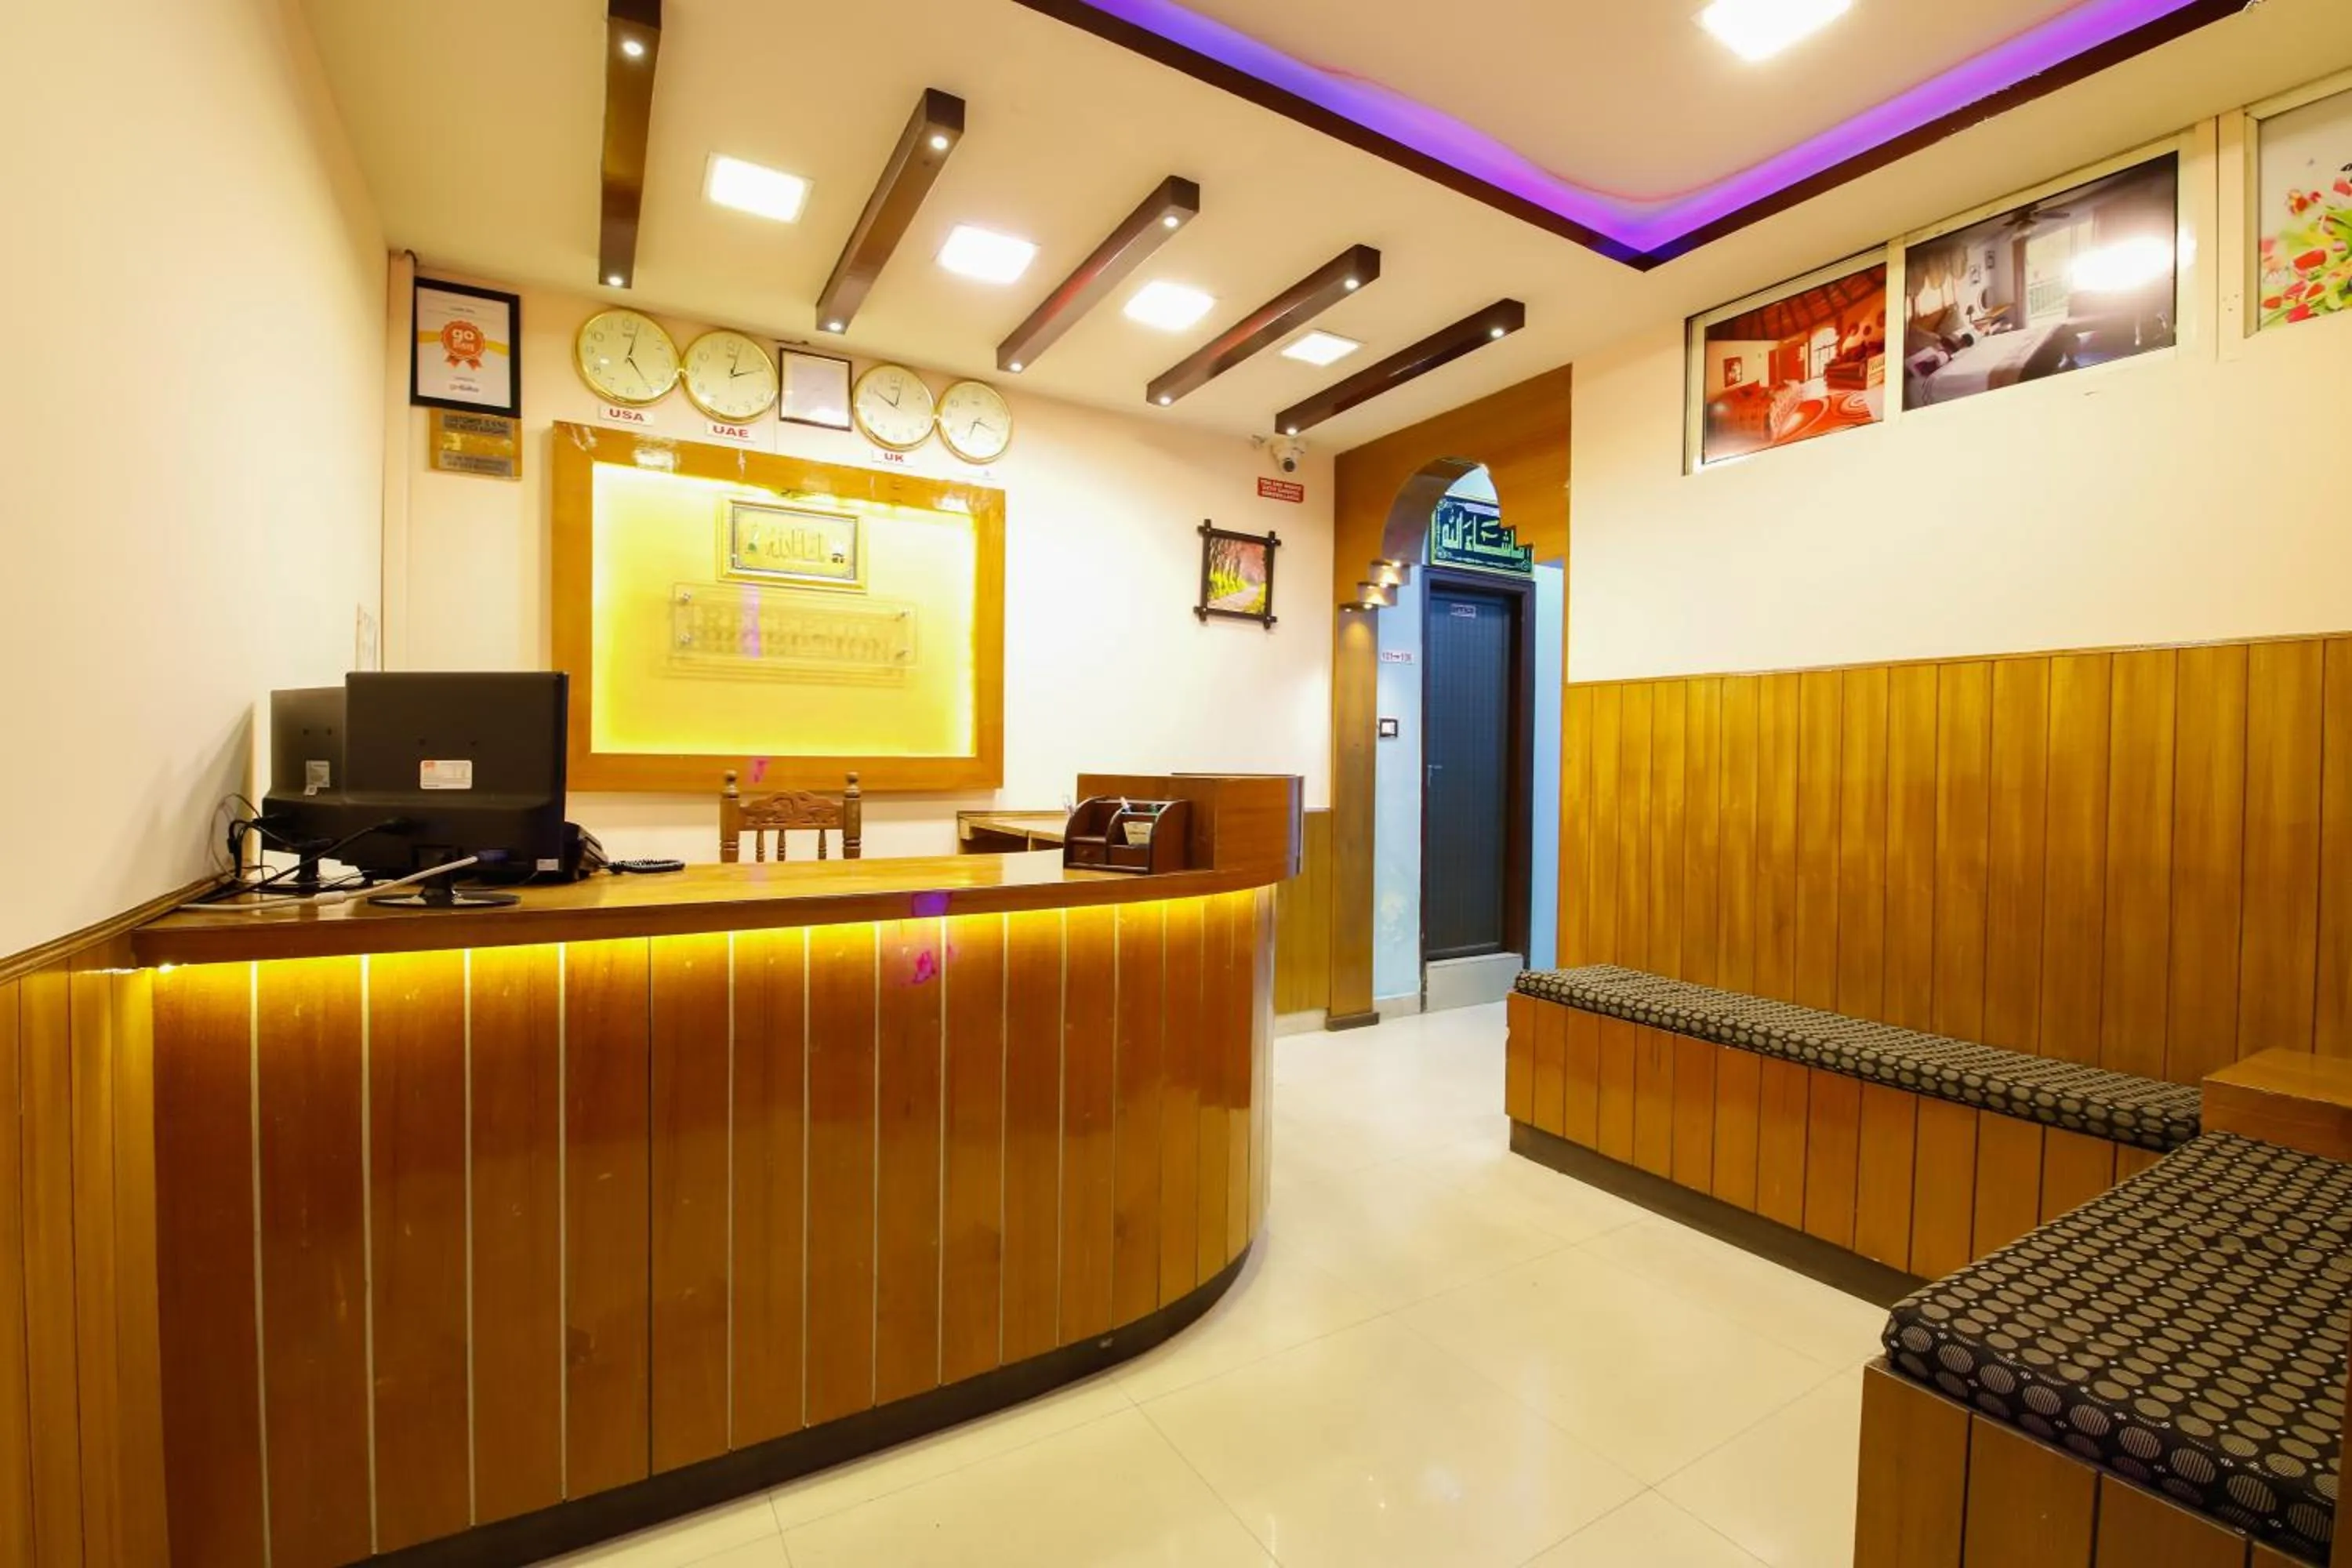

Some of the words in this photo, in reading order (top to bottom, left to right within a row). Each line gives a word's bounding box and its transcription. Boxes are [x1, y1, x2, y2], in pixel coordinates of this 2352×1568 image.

[608, 408, 644, 422] USA
[713, 425, 750, 438] UAE
[884, 452, 904, 463] UK
